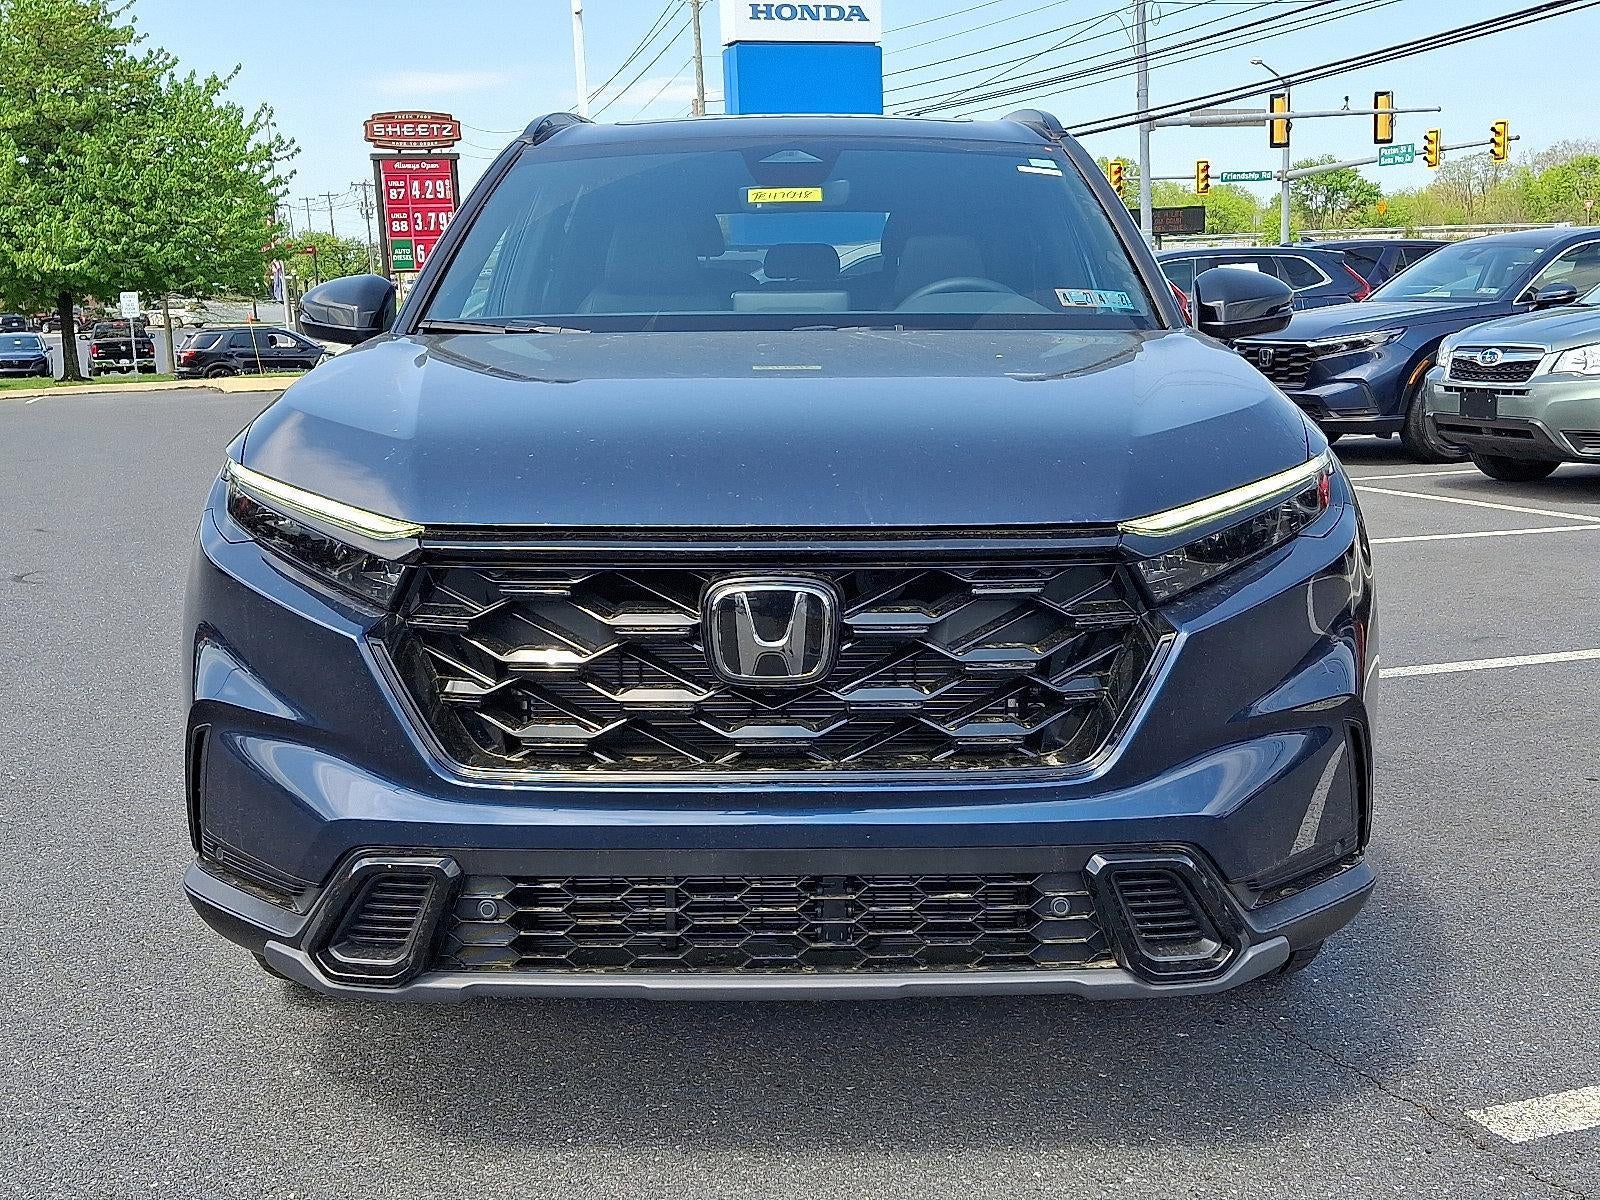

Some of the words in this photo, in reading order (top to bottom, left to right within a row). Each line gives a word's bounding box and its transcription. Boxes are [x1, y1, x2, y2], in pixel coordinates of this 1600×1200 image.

[749, 4, 870, 21] HONDA
[373, 123, 454, 136] SHEETZ
[394, 162, 420, 170] Always
[421, 162, 439, 170] Open
[1222, 172, 1260, 181] Friendship
[1261, 171, 1272, 179] Rd
[389, 188, 405, 199] 87
[391, 220, 408, 232] 88
